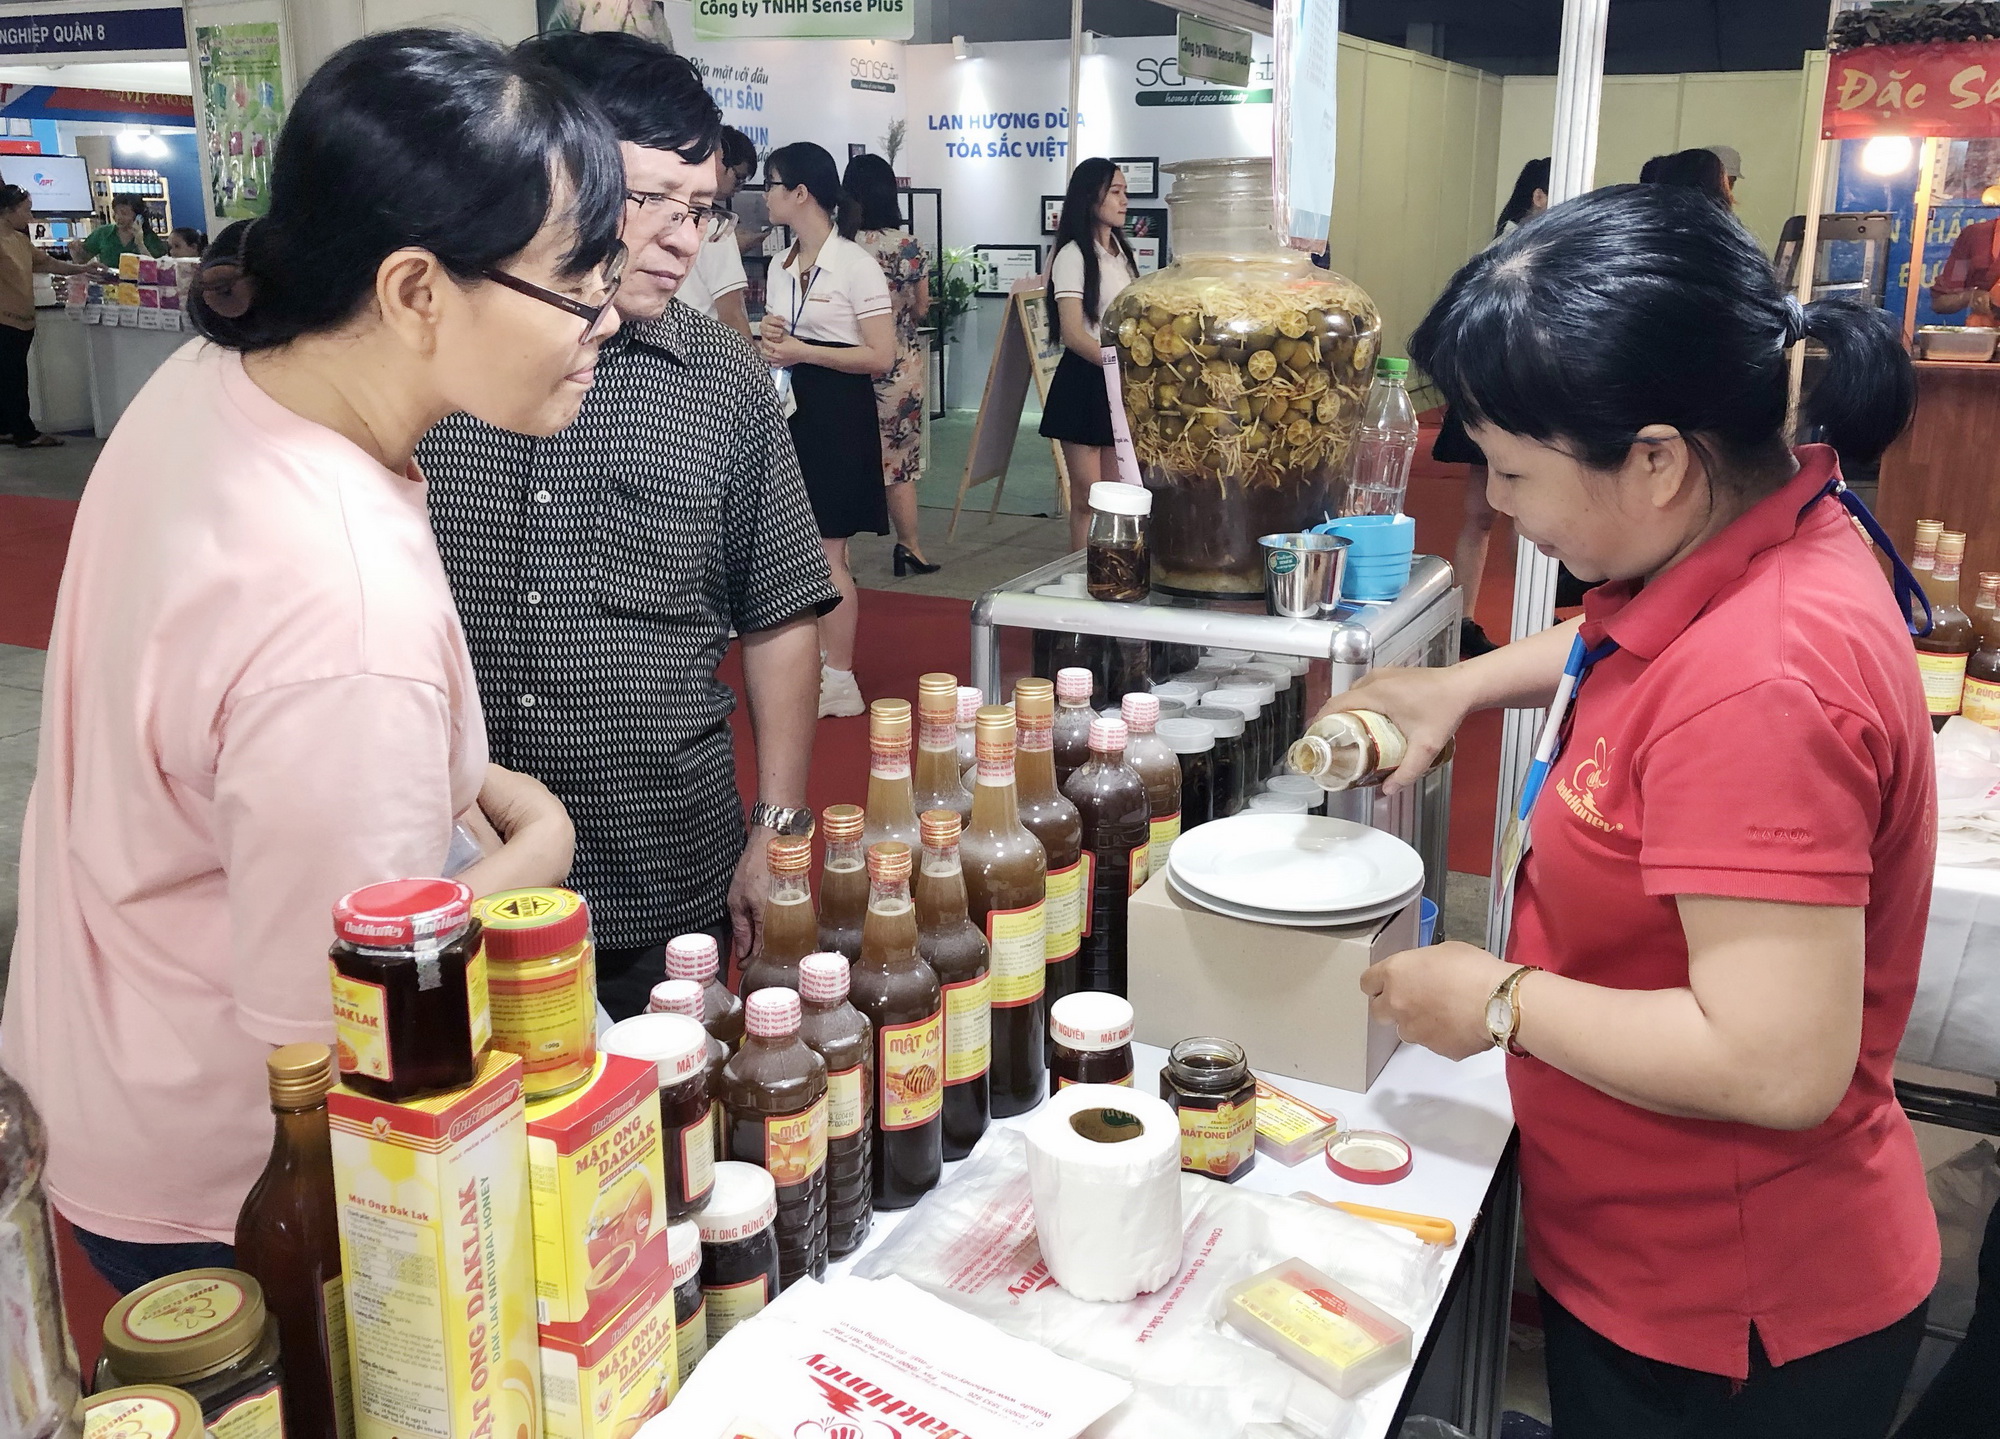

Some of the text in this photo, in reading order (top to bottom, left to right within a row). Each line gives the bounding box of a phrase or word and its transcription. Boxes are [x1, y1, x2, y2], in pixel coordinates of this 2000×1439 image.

[700, 0, 904, 17] Công ty TNHH Sense Plus
[97, 24, 105, 40] 8
[712, 65, 733, 84] mặt
[735, 66, 750, 82] với
[737, 85, 763, 111] SÂU
[1165, 91, 1248, 105] home of coco beauty
[1837, 68, 1927, 118] Đặc
[928, 114, 963, 131] LAN
[969, 111, 1040, 130] HƯƠNG
[946, 133, 1068, 163] TỎA SẮC VIỆT
[356, 1012, 378, 1028] LAK
[1059, 1021, 1085, 1041] NGUYÊN
[890, 1034, 922, 1055] MẬT
[677, 1055, 695, 1074] MẬT
[780, 1121, 806, 1140] MẬT
[1181, 1128, 1202, 1140] MẬT
[1204, 1131, 1225, 1140] ONG
[576, 1115, 641, 1175] MẬT ONG
[598, 1120, 656, 1177] DAKLAK
[719, 1227, 738, 1240] ONG
[1200, 1248, 1211, 1257] TY
[480, 1176, 501, 1363] DAK LAK NATURAL HONEY
[458, 1176, 496, 1439] ẬT ONG DAKLAK
[598, 1316, 658, 1385] MẬT ONG
[619, 1318, 671, 1382] DAKLAK
